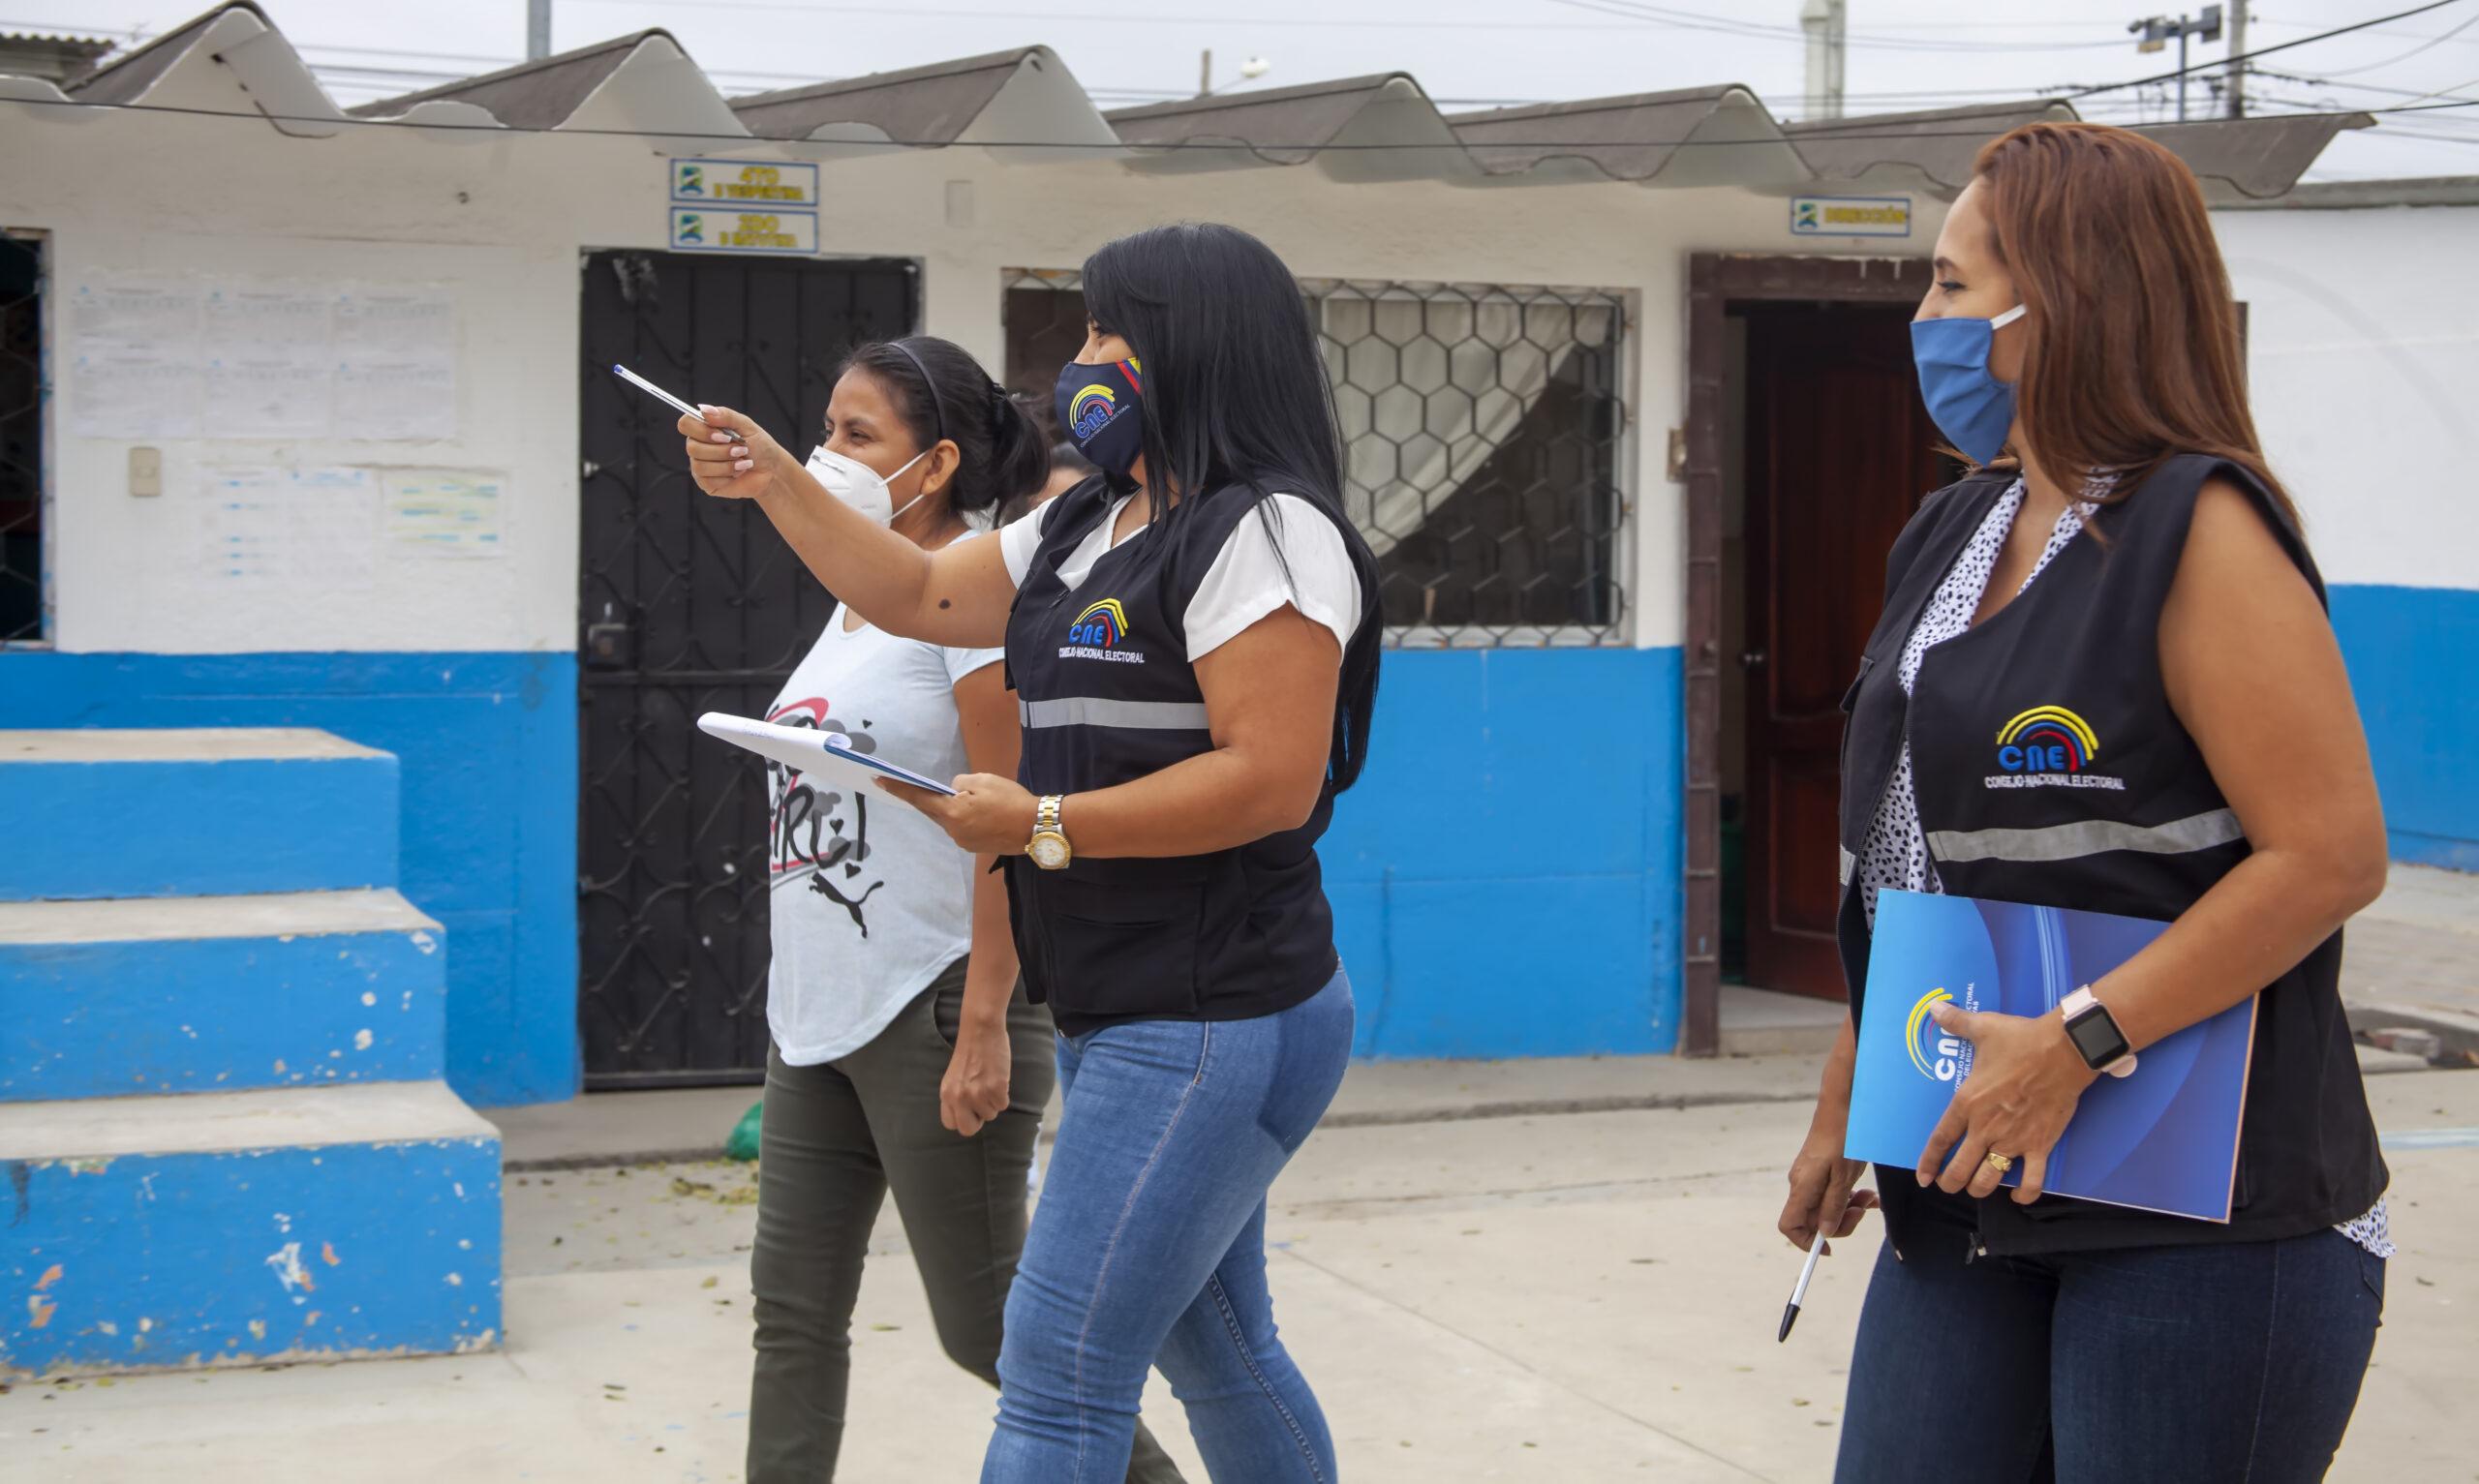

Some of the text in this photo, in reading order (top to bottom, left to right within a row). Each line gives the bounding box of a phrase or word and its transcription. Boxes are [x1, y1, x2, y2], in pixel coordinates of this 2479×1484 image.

[1105, 650, 1145, 664] ELECTORAL
[2025, 773, 2072, 788] NACIONAL
[2071, 775, 2126, 790] ELECTORAL
